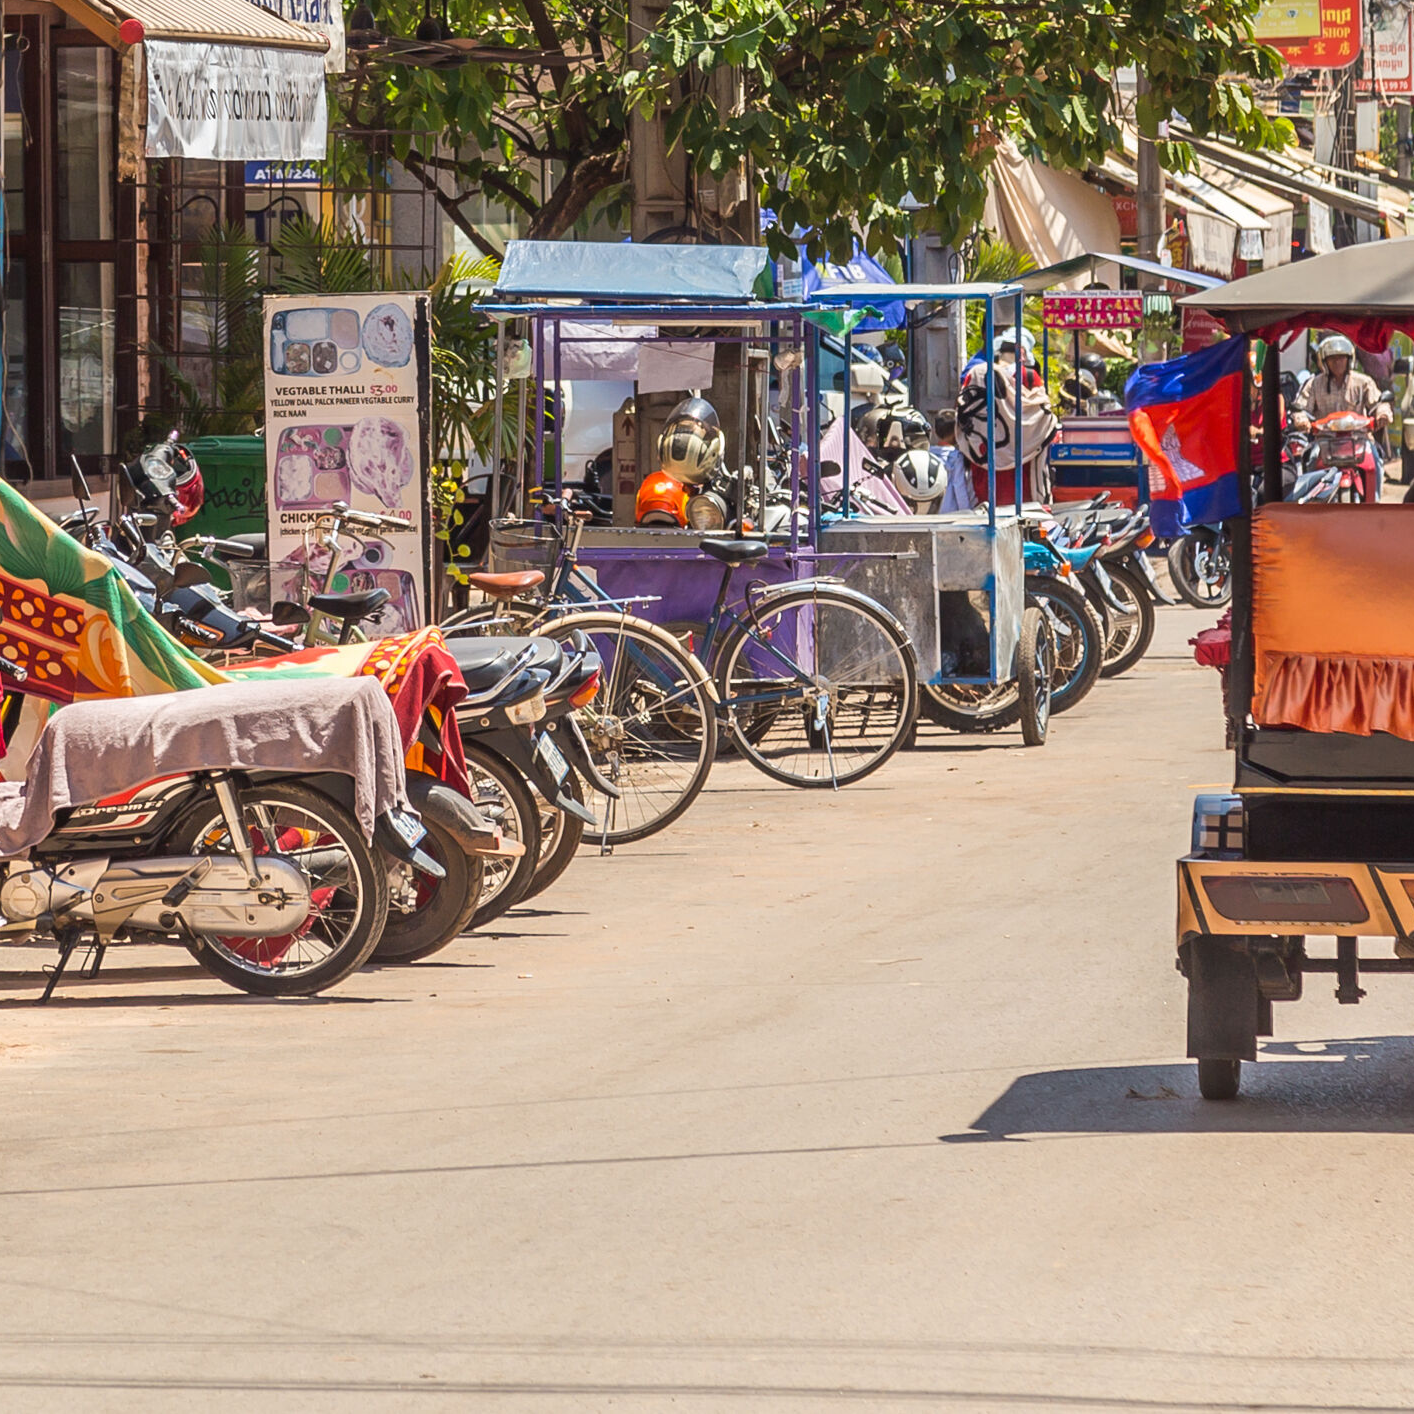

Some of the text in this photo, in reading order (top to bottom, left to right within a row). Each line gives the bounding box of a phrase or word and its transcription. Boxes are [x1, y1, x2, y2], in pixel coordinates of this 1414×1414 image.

[275, 386, 327, 396] VEGTABLE
[329, 386, 366, 395] THALLI
[270, 398, 296, 407] YELLOW
[296, 398, 314, 406] DAAL
[335, 397, 361, 406] PANEER
[361, 396, 394, 405] VEGTABLE
[393, 396, 415, 404] CURRY
[273, 409, 307, 418] RICE NAAN
[79, 802, 143, 817] Dream
